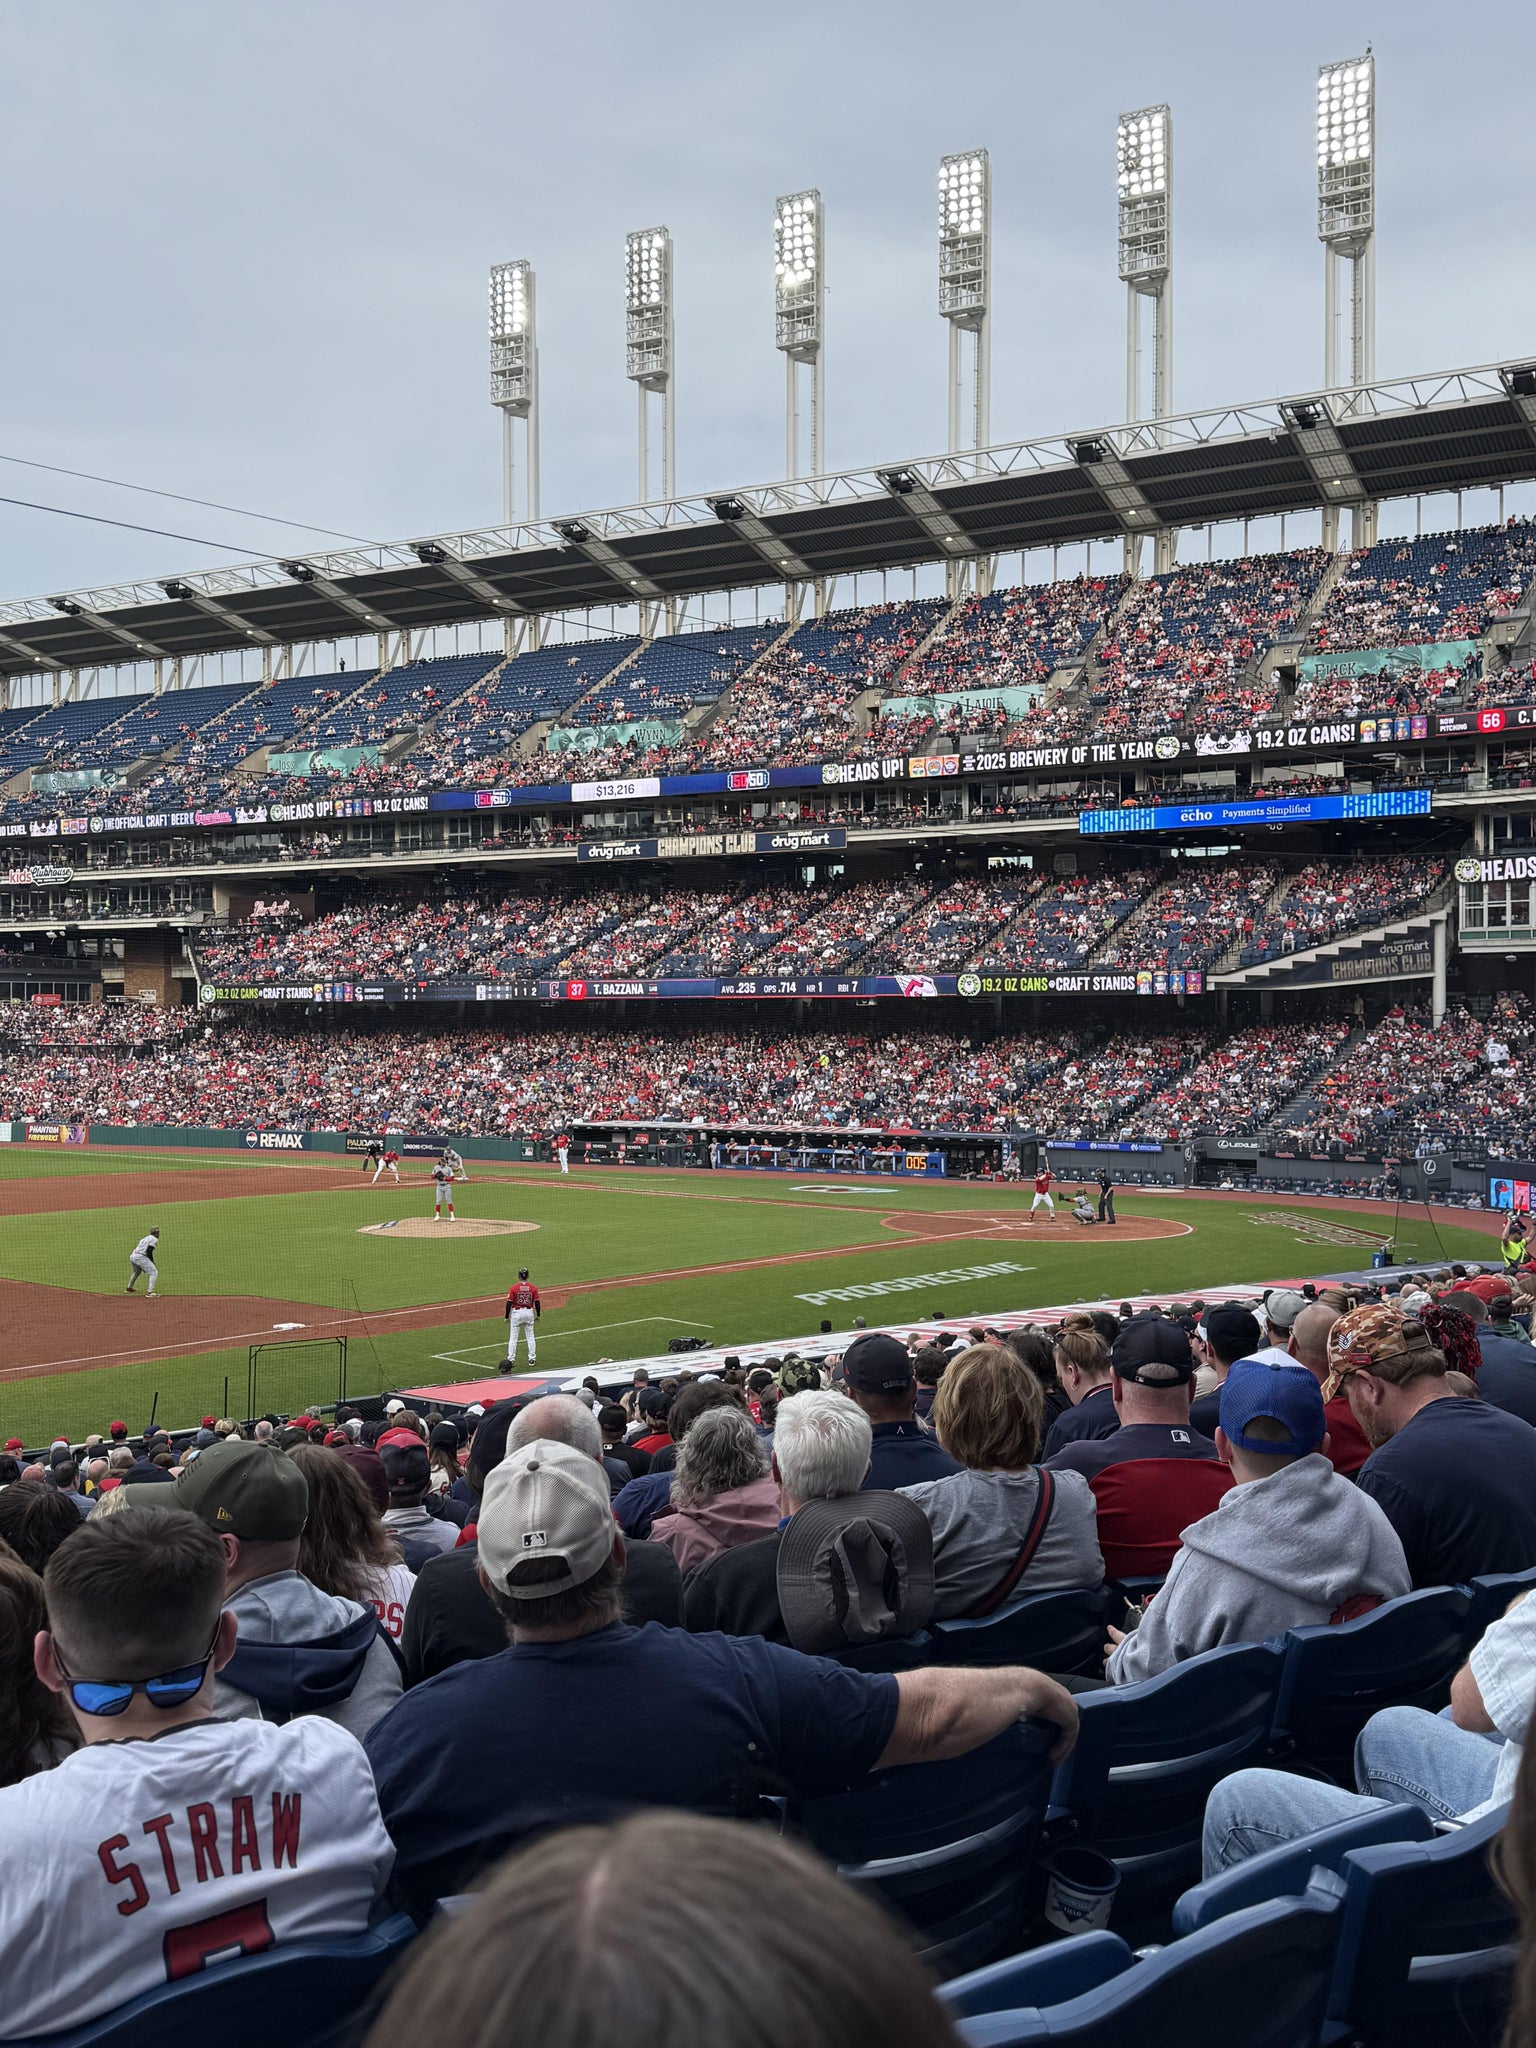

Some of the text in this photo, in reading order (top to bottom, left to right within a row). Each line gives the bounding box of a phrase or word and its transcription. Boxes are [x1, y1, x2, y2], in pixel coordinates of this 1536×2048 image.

[1482, 713, 1500, 728] 56
[635, 728, 666, 742] WYNN
[1255, 724, 1355, 749] 19.2 OZ CANS!
[976, 753, 1006, 770] 2025
[1009, 746, 1068, 768] BREWERY
[1072, 746, 1089, 763] OF
[1091, 744, 1119, 762] THE
[1121, 741, 1153, 759] YEAR
[838, 763, 879, 783] HEADS
[882, 759, 904, 779] UP!
[595, 784, 635, 797] $13,216
[283, 802, 314, 820] HEADS
[316, 801, 333, 816] UP!
[373, 797, 428, 813] 19.2 OZ CANS!
[114, 815, 145, 829] OFFICIAL
[146, 814, 168, 827] CRAFT
[171, 812, 189, 826] BEER
[1180, 804, 1311, 822] echo Payments Simplified
[7, 825, 27, 836] LEVEL
[657, 833, 756, 857] CHAMPIONS CLUB
[771, 833, 830, 849] drug mart
[588, 844, 641, 859] drug mart
[31, 866, 71, 877] Clubhouse
[1481, 856, 1536, 881] HEADS
[9, 869, 32, 884] kids
[1380, 944, 1403, 955] drug
[1404, 940, 1429, 952] mart
[1331, 956, 1399, 979] CHAMPIONS
[1401, 953, 1432, 972] CLUB
[571, 984, 582, 996] 37
[593, 984, 602, 994] T.
[603, 983, 644, 995] BAZZANA
[736, 982, 756, 993] .235
[763, 982, 796, 993] OPS .714
[818, 981, 823, 992] 1
[838, 981, 858, 992] RBI 7
[982, 978, 1001, 992] 19.2
[1004, 978, 1018, 991] OZ
[1020, 977, 1048, 991] CANS
[1056, 977, 1090, 991] CRAFT
[1092, 976, 1135, 991] STANDS
[216, 988, 229, 1000] 19.2
[230, 988, 240, 999] OZ
[240, 988, 258, 999] CANS
[262, 987, 285, 998] CRAFT
[286, 987, 313, 998] STANDS
[28, 1125, 59, 1134] PHANTOM
[28, 1134, 59, 1142] FIREWORKS
[793, 1261, 1037, 1306] PROGRESSIVE
[98, 1791, 302, 1917] STRAW
